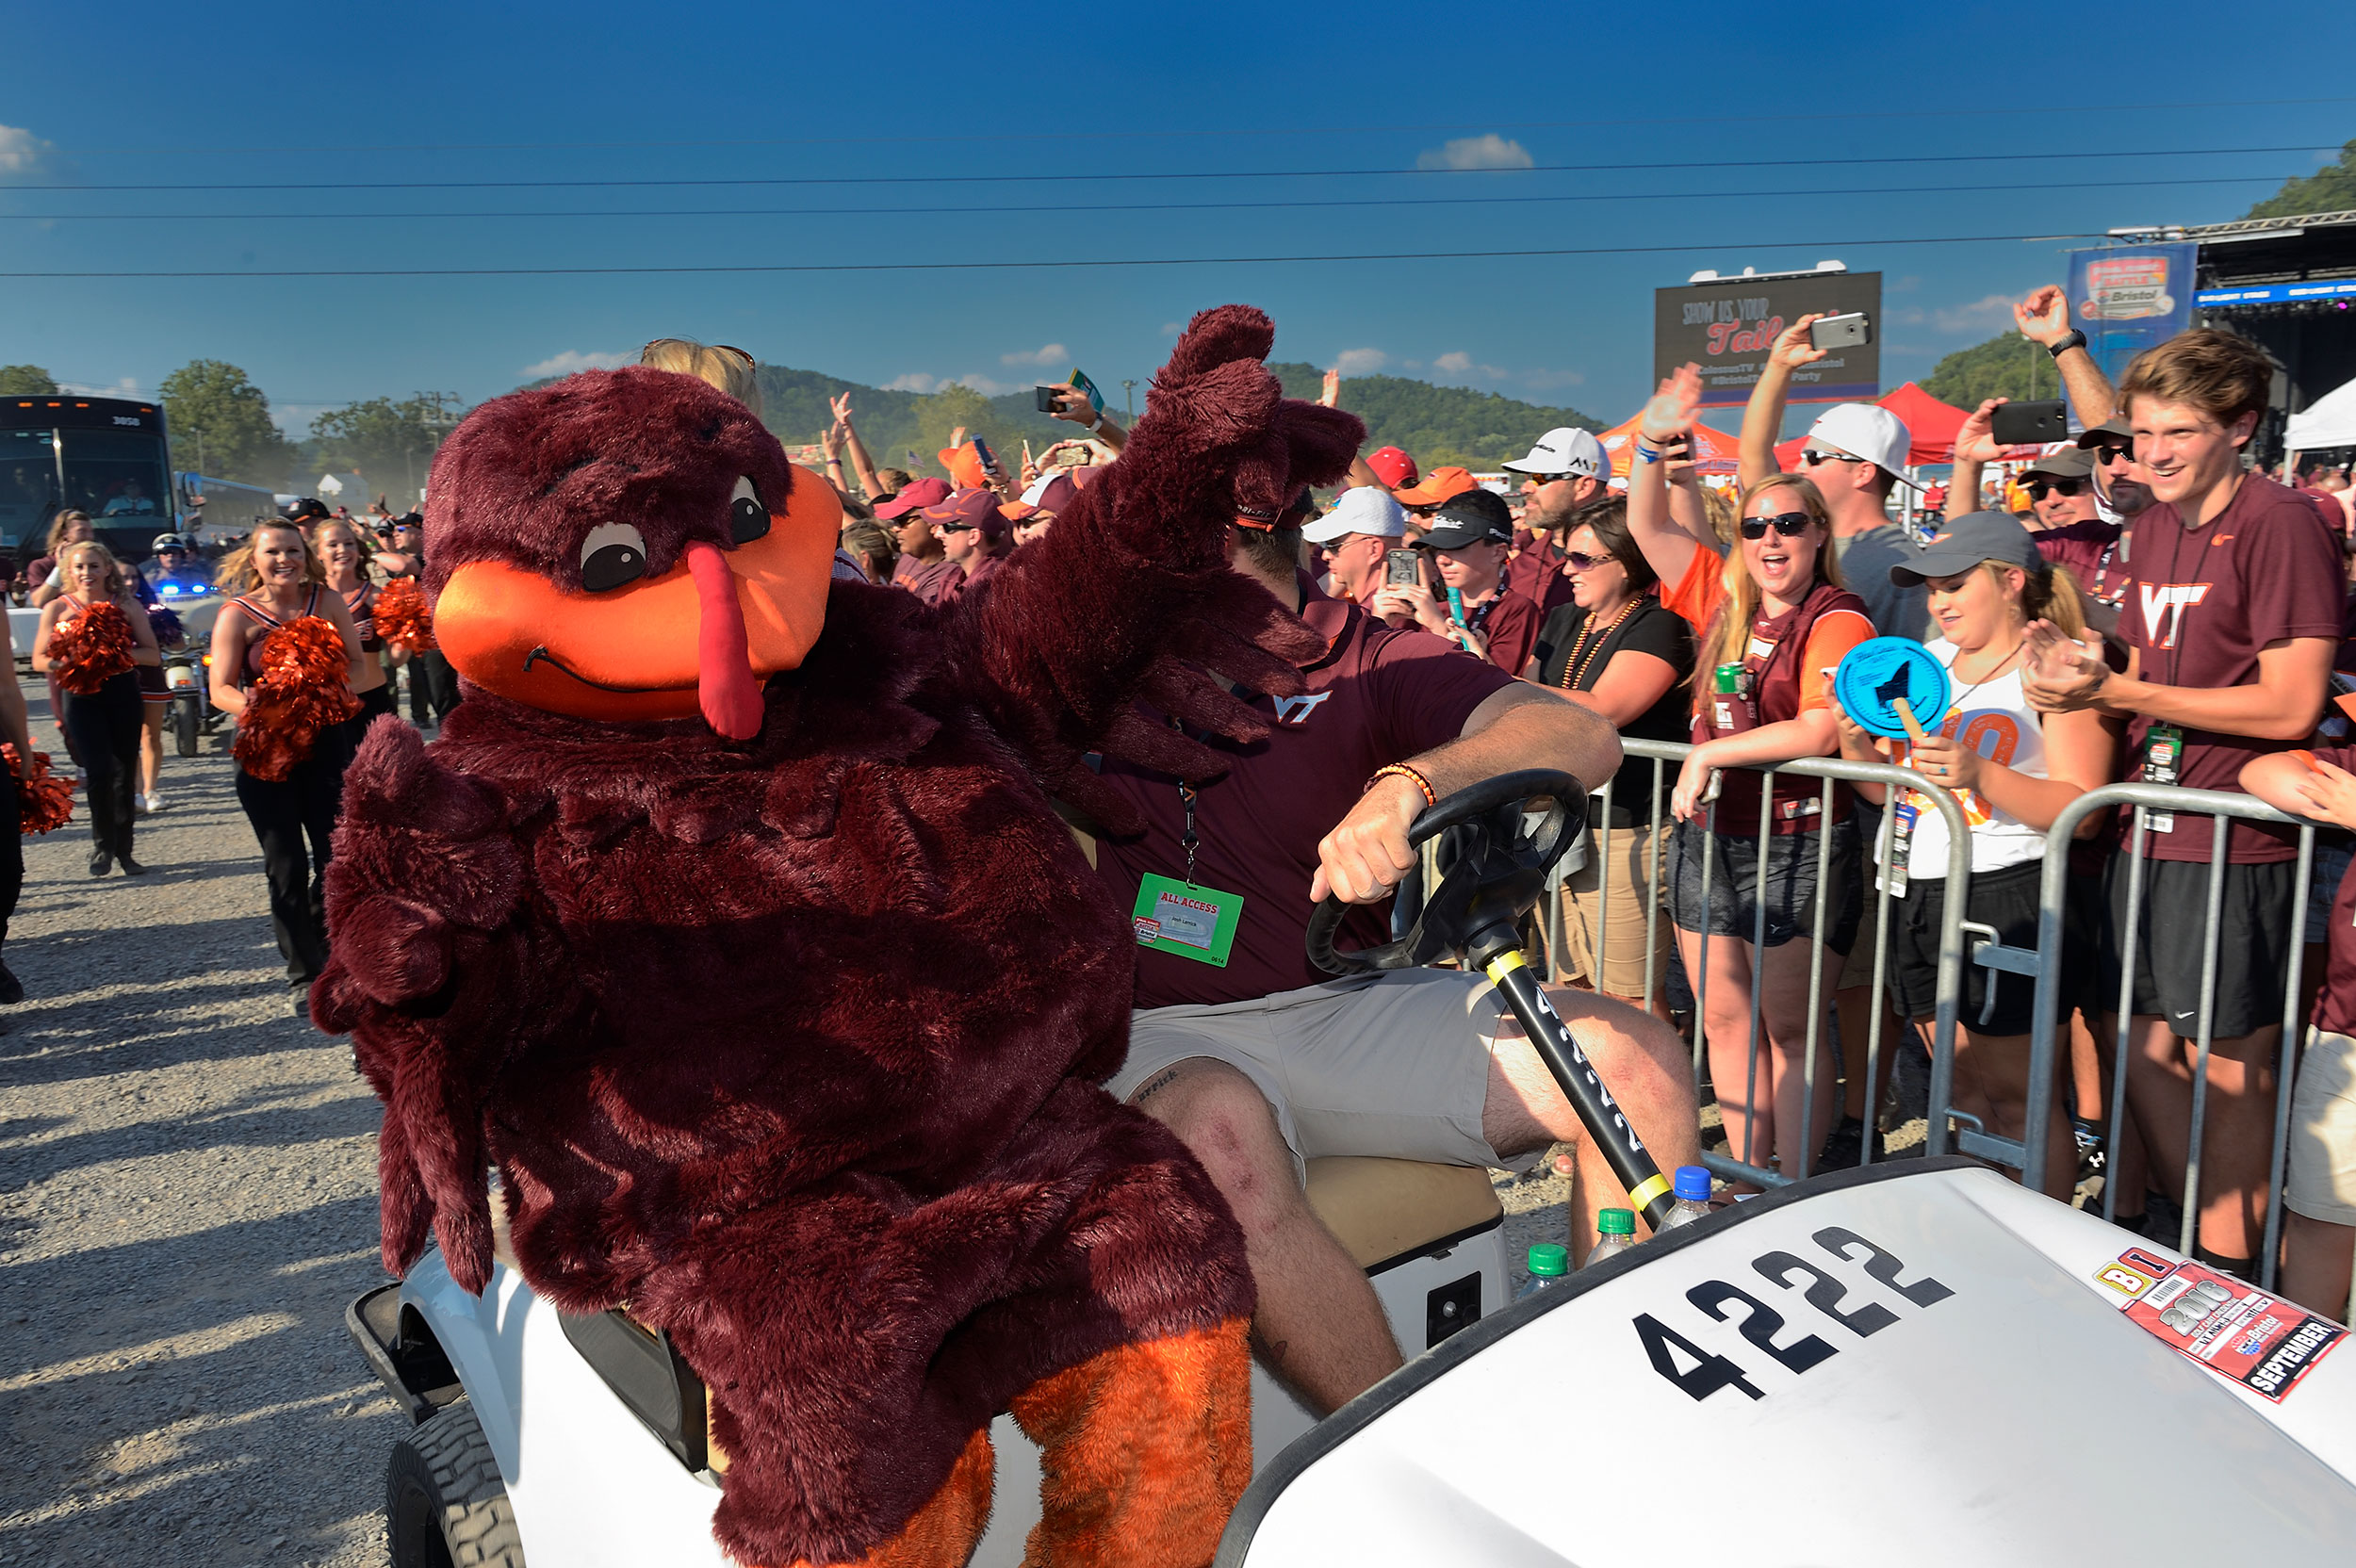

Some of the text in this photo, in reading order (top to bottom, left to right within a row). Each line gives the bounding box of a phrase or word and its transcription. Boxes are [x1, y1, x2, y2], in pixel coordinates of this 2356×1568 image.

[1682, 298, 1769, 325] SHOW US YOUR
[2112, 289, 2157, 302] Bristol
[2138, 581, 2214, 650] VT
[1272, 690, 1333, 725] VT
[1160, 892, 1219, 915] ALL ACCESS
[1631, 1225, 1957, 1402] 4222
[2159, 1280, 2233, 1338] 2016
[2247, 1314, 2280, 1339] Bristol
[2250, 1321, 2332, 1392] SEPTEMBER
